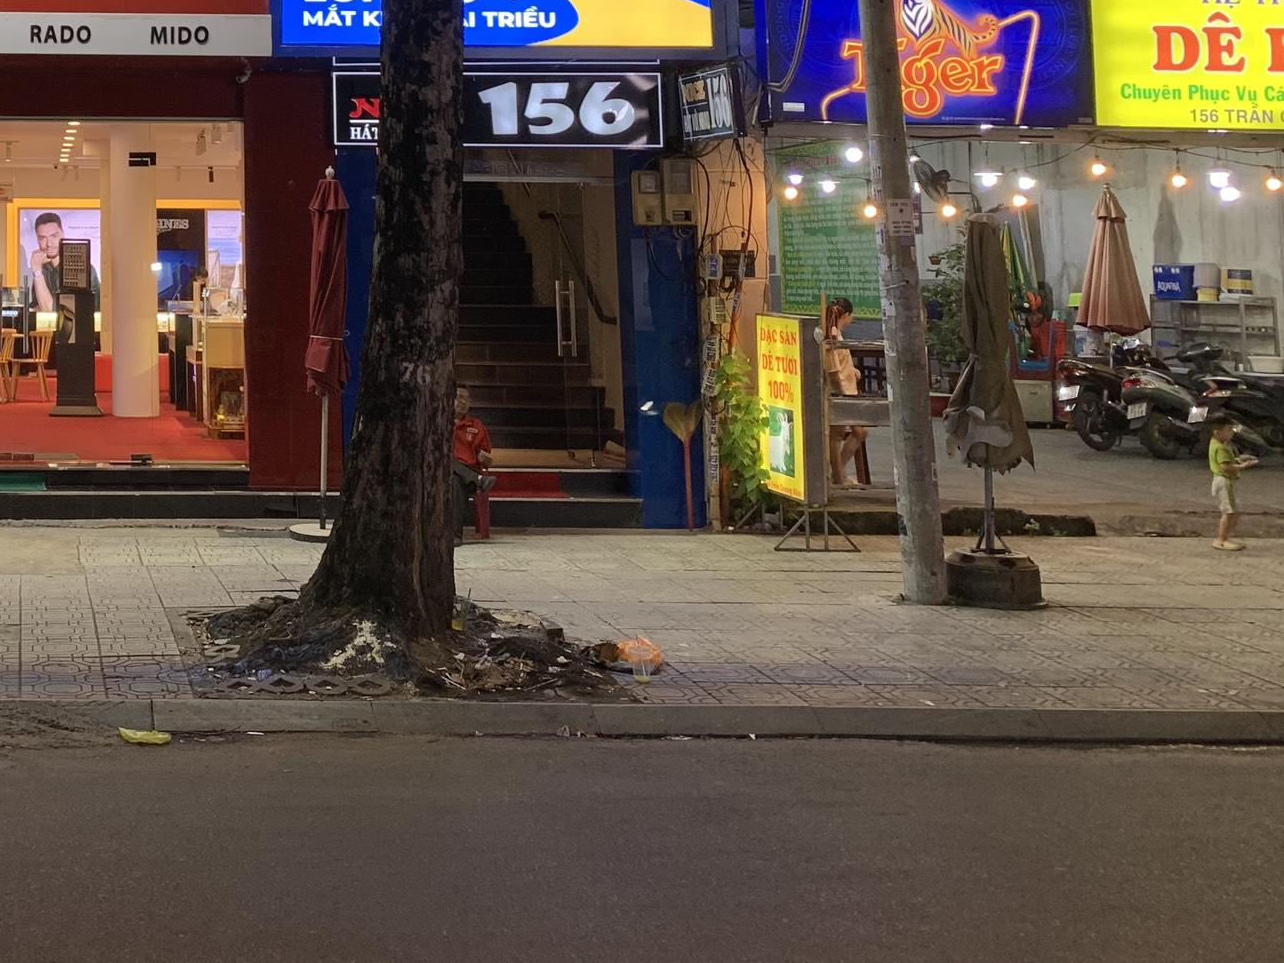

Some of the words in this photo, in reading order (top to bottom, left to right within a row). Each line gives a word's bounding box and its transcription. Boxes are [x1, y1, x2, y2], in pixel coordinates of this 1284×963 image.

[302, 3, 357, 27] MẮT
[482, 4, 557, 29] TRIỀU
[30, 26, 92, 45] RADO
[150, 27, 210, 46] MIDO
[1152, 11, 1246, 73] DÊ
[842, 38, 1005, 118] Tger
[1120, 83, 1182, 103] Chuyên
[1188, 84, 1230, 104] Phục
[1236, 85, 1258, 106] Vụ
[1264, 85, 1284, 102] Cá
[478, 81, 637, 136] 156
[1190, 108, 1219, 123] 156
[157, 218, 190, 230] INES
[767, 380, 795, 403] 100%
